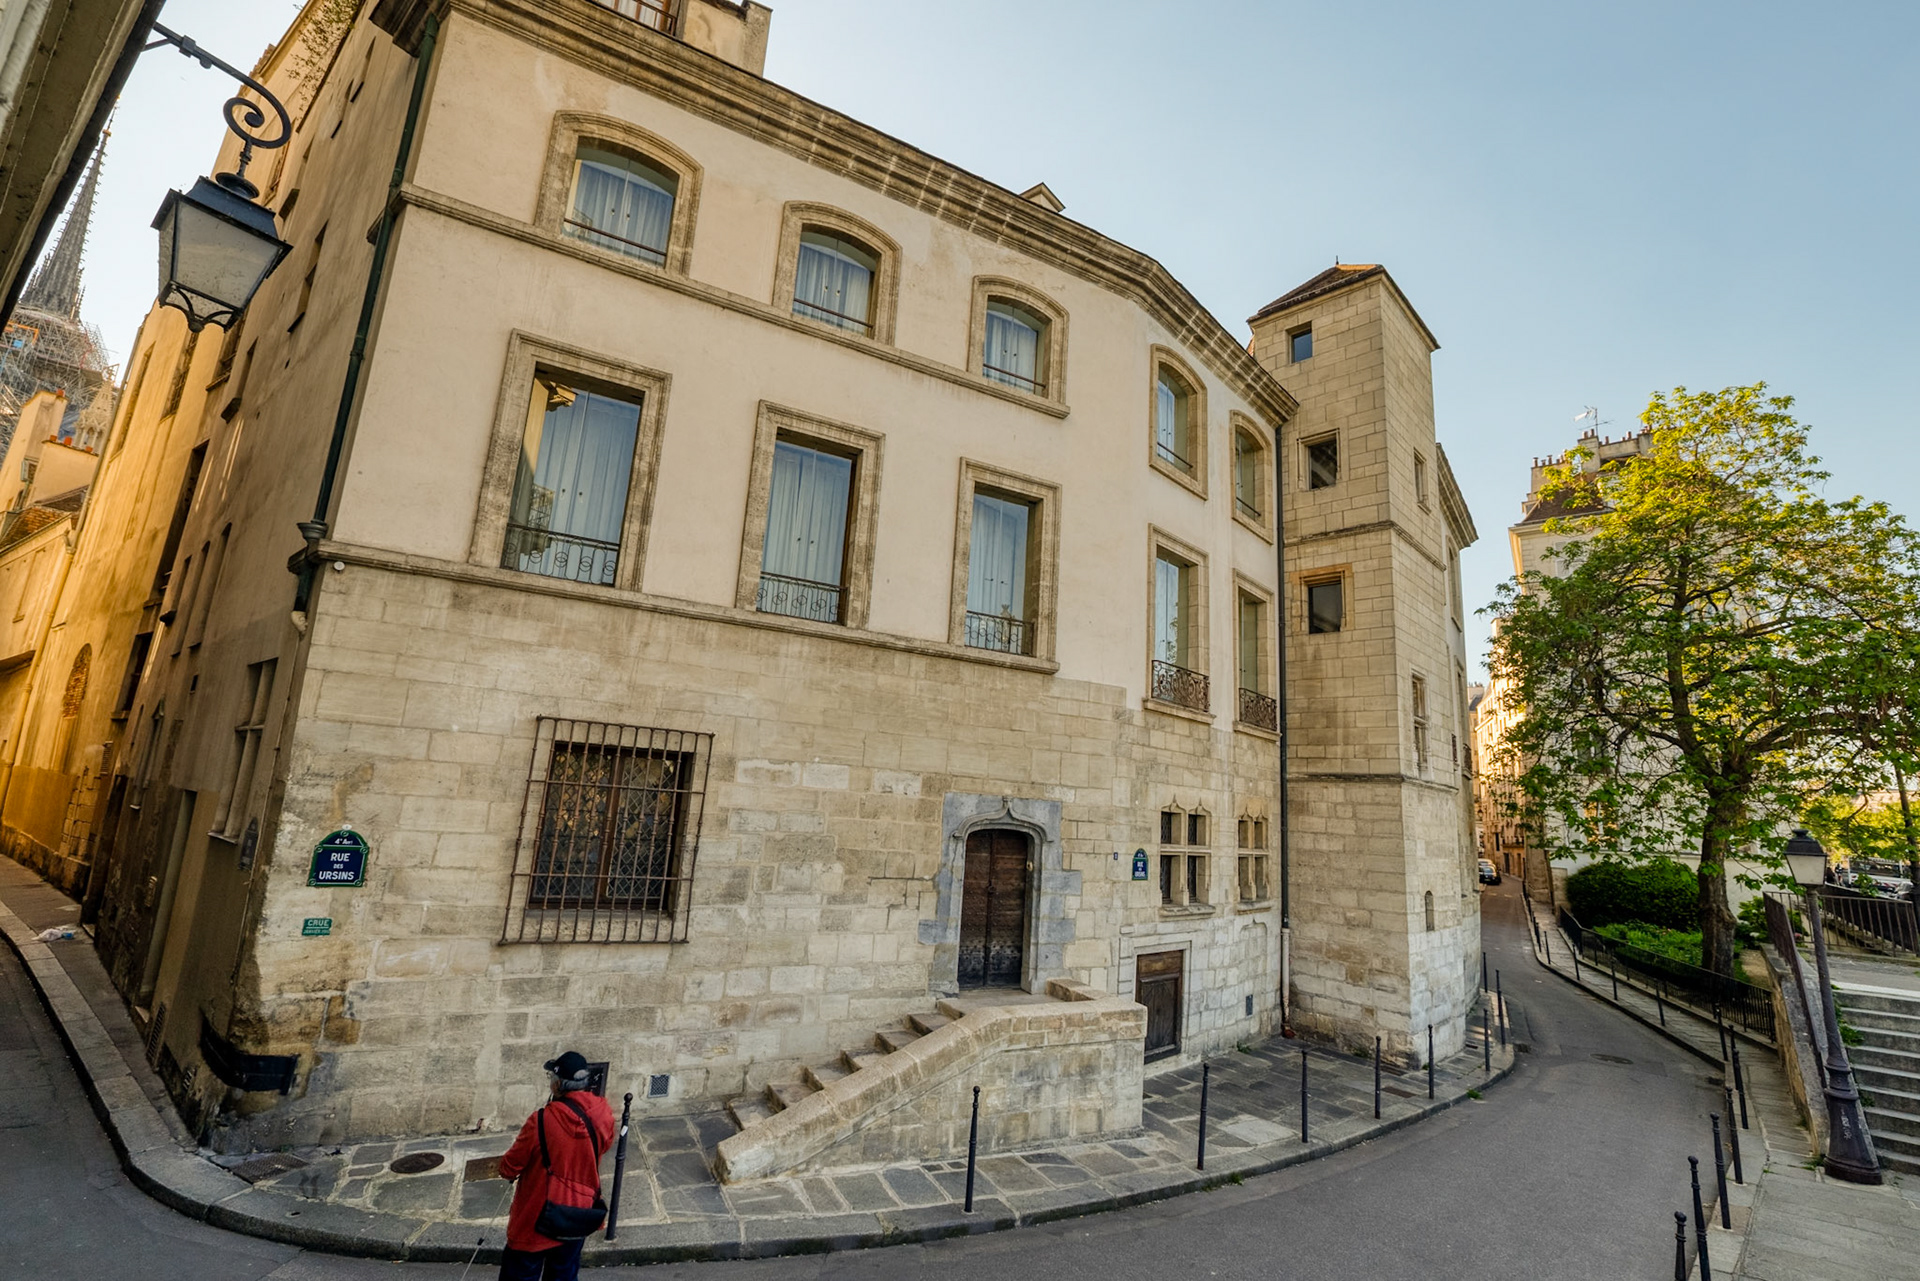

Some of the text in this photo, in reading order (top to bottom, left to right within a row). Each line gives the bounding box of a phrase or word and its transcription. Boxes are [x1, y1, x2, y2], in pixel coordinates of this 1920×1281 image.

[330, 853, 351, 862] RUE
[318, 871, 355, 880] URSINS
[307, 919, 329, 927] CRUE
